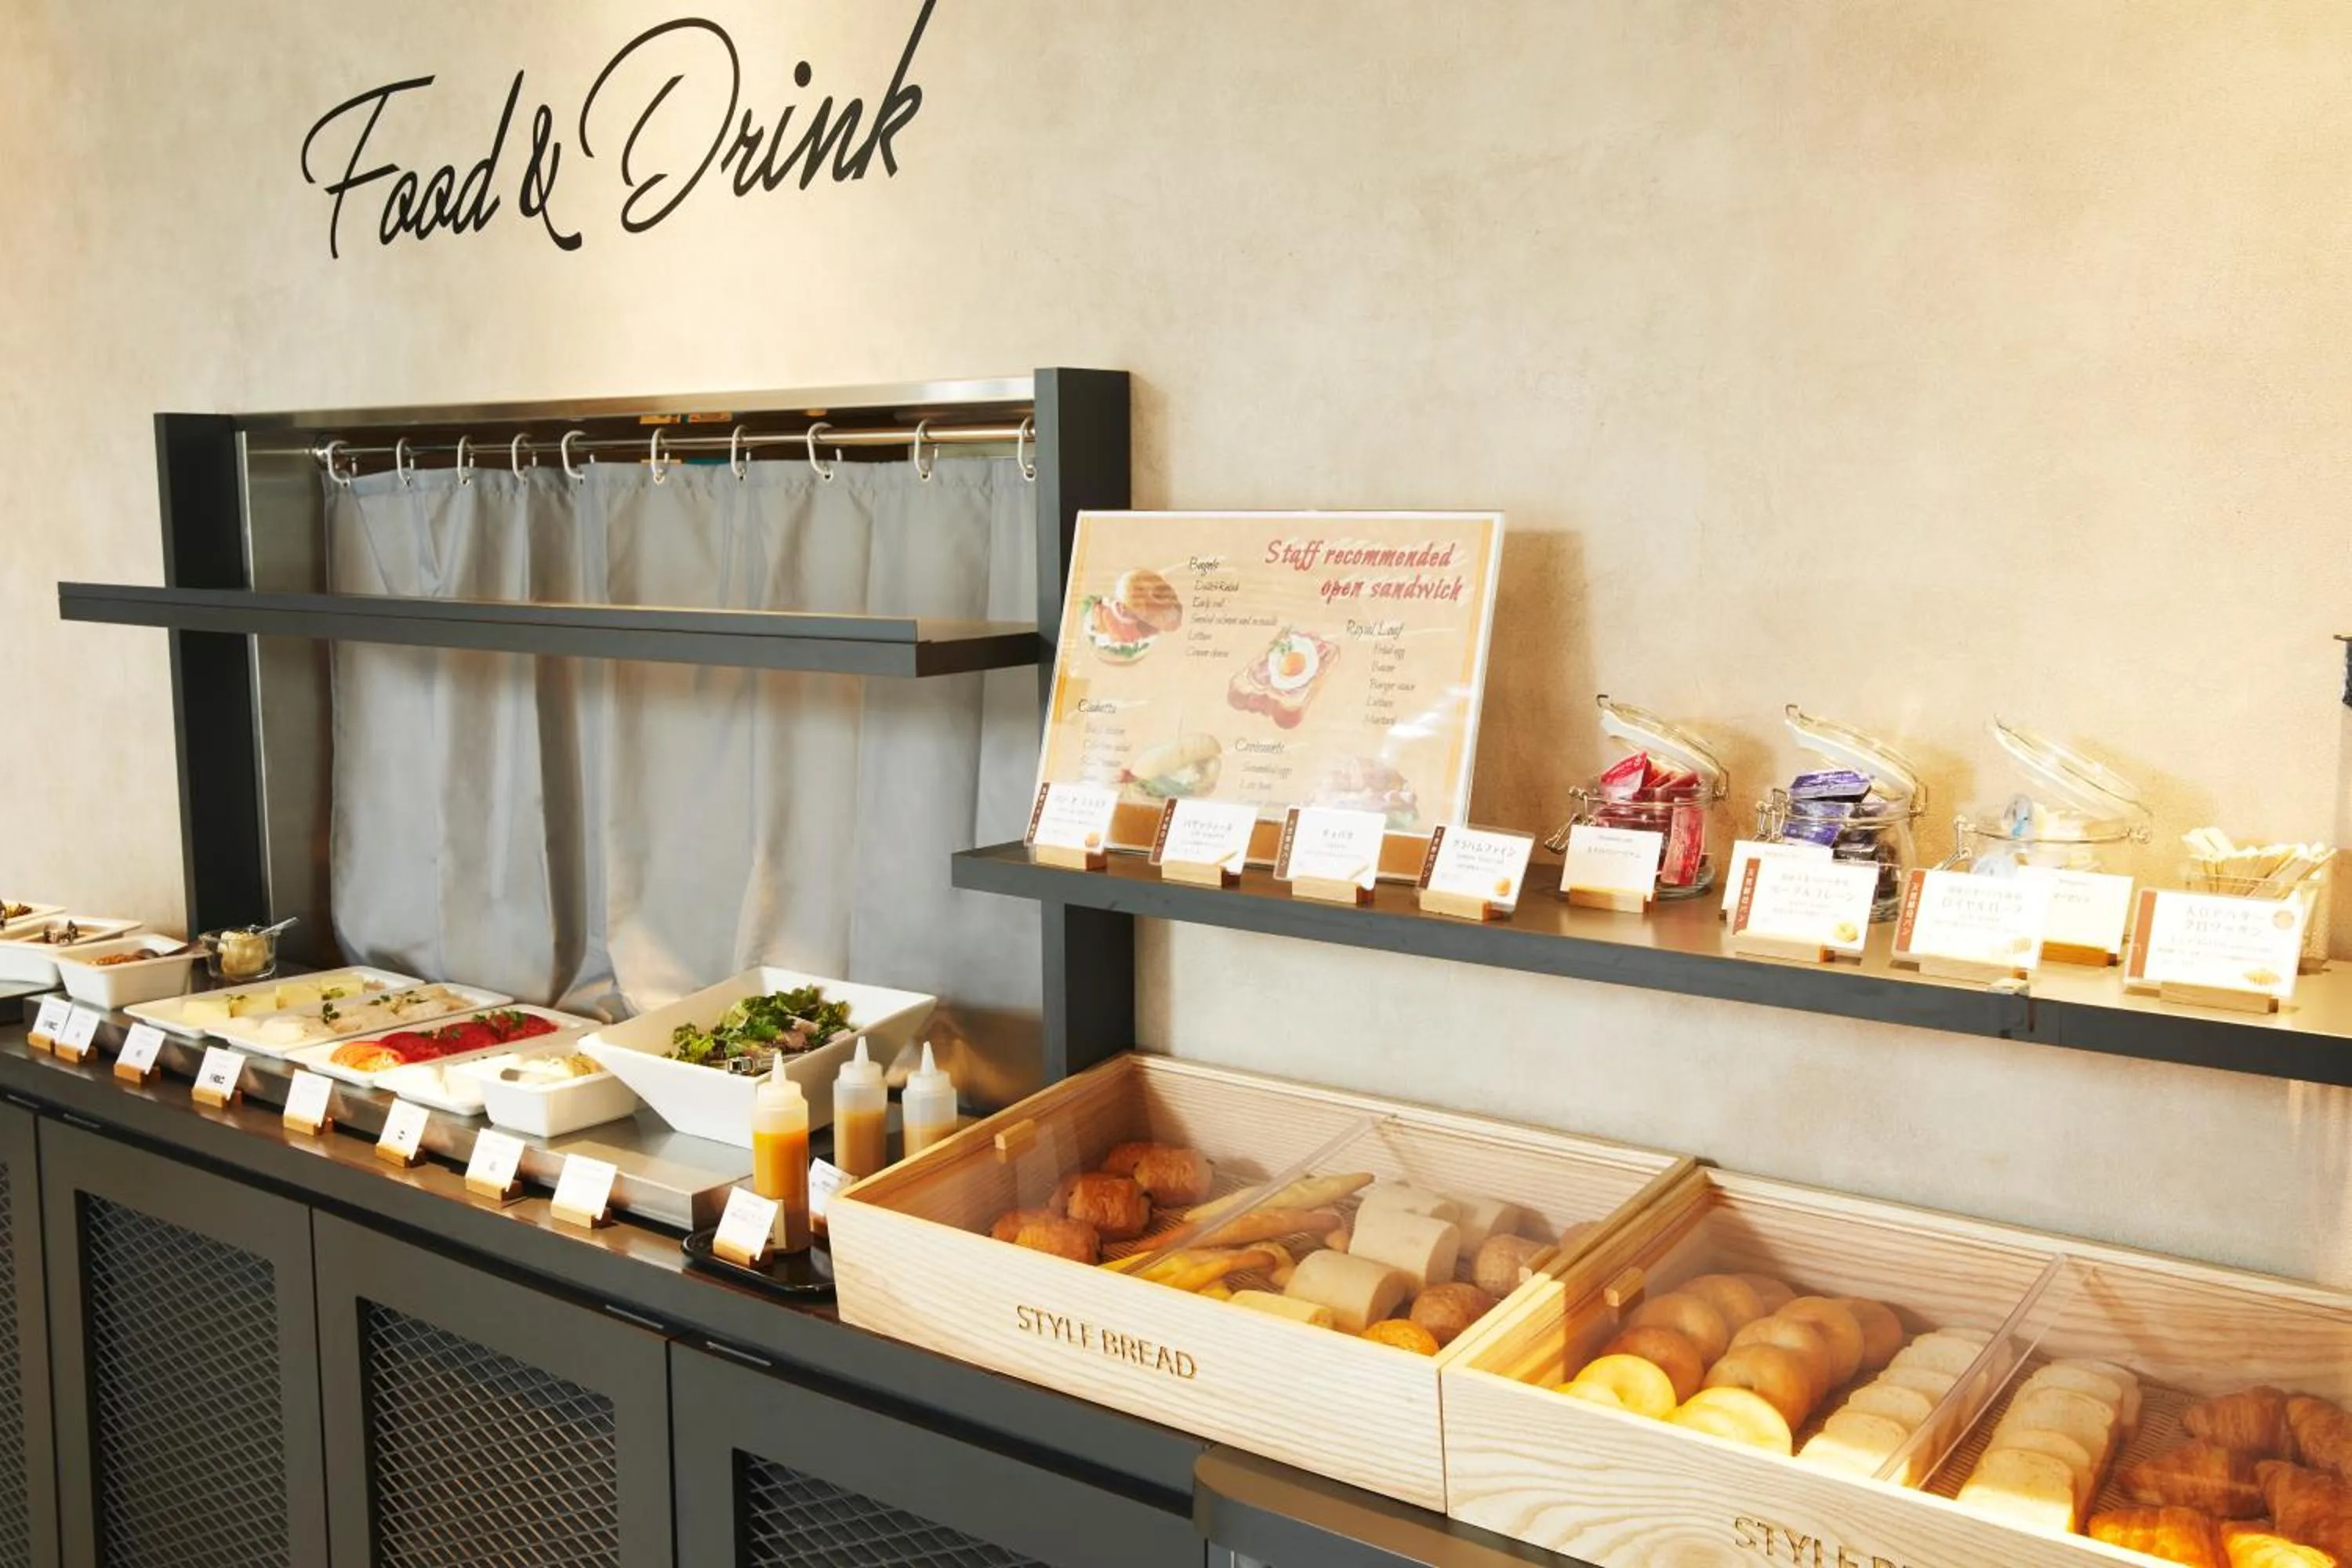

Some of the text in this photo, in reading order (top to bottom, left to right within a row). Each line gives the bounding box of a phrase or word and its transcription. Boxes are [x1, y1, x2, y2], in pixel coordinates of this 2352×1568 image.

[301, 0, 936, 259] Food & Drink
[1265, 539, 1455, 572] Staff recommended
[1320, 575, 1463, 605] open sandwich
[1346, 619, 1376, 641] Royal
[1017, 1305, 1197, 1379] STYLE BREAD
